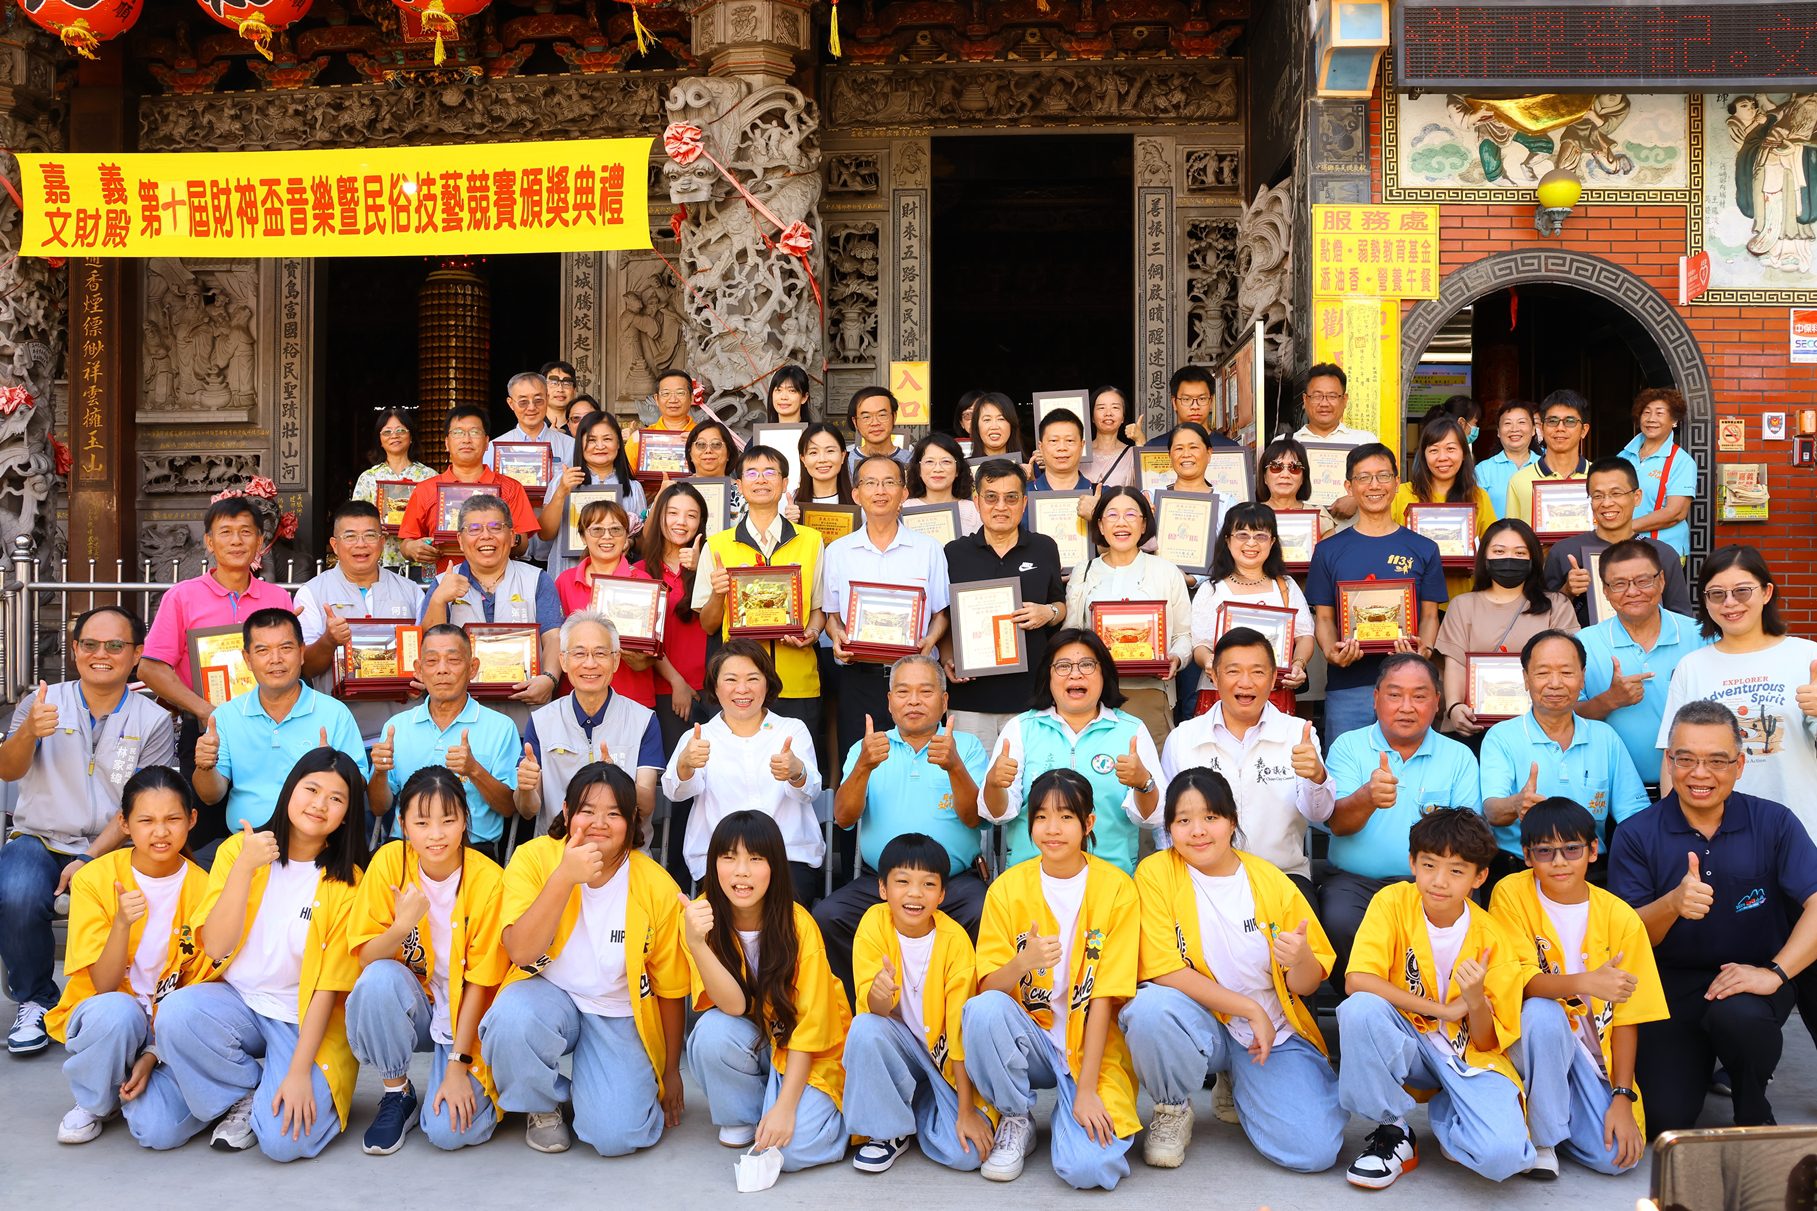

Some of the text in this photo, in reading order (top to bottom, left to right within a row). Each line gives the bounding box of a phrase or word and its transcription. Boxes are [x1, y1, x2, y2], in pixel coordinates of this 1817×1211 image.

[39, 162, 128, 206] 嘉義
[138, 162, 625, 238] 第十屆財神盃音樂暨民俗技藝競賽頒獎典禮
[40, 207, 131, 248] 文財殿
[1323, 210, 1428, 231] 服務處
[897, 369, 922, 417] 入口
[1387, 554, 1406, 566] 113
[1723, 676, 1768, 687] EXPLORER
[1751, 692, 1785, 706] Spirit
